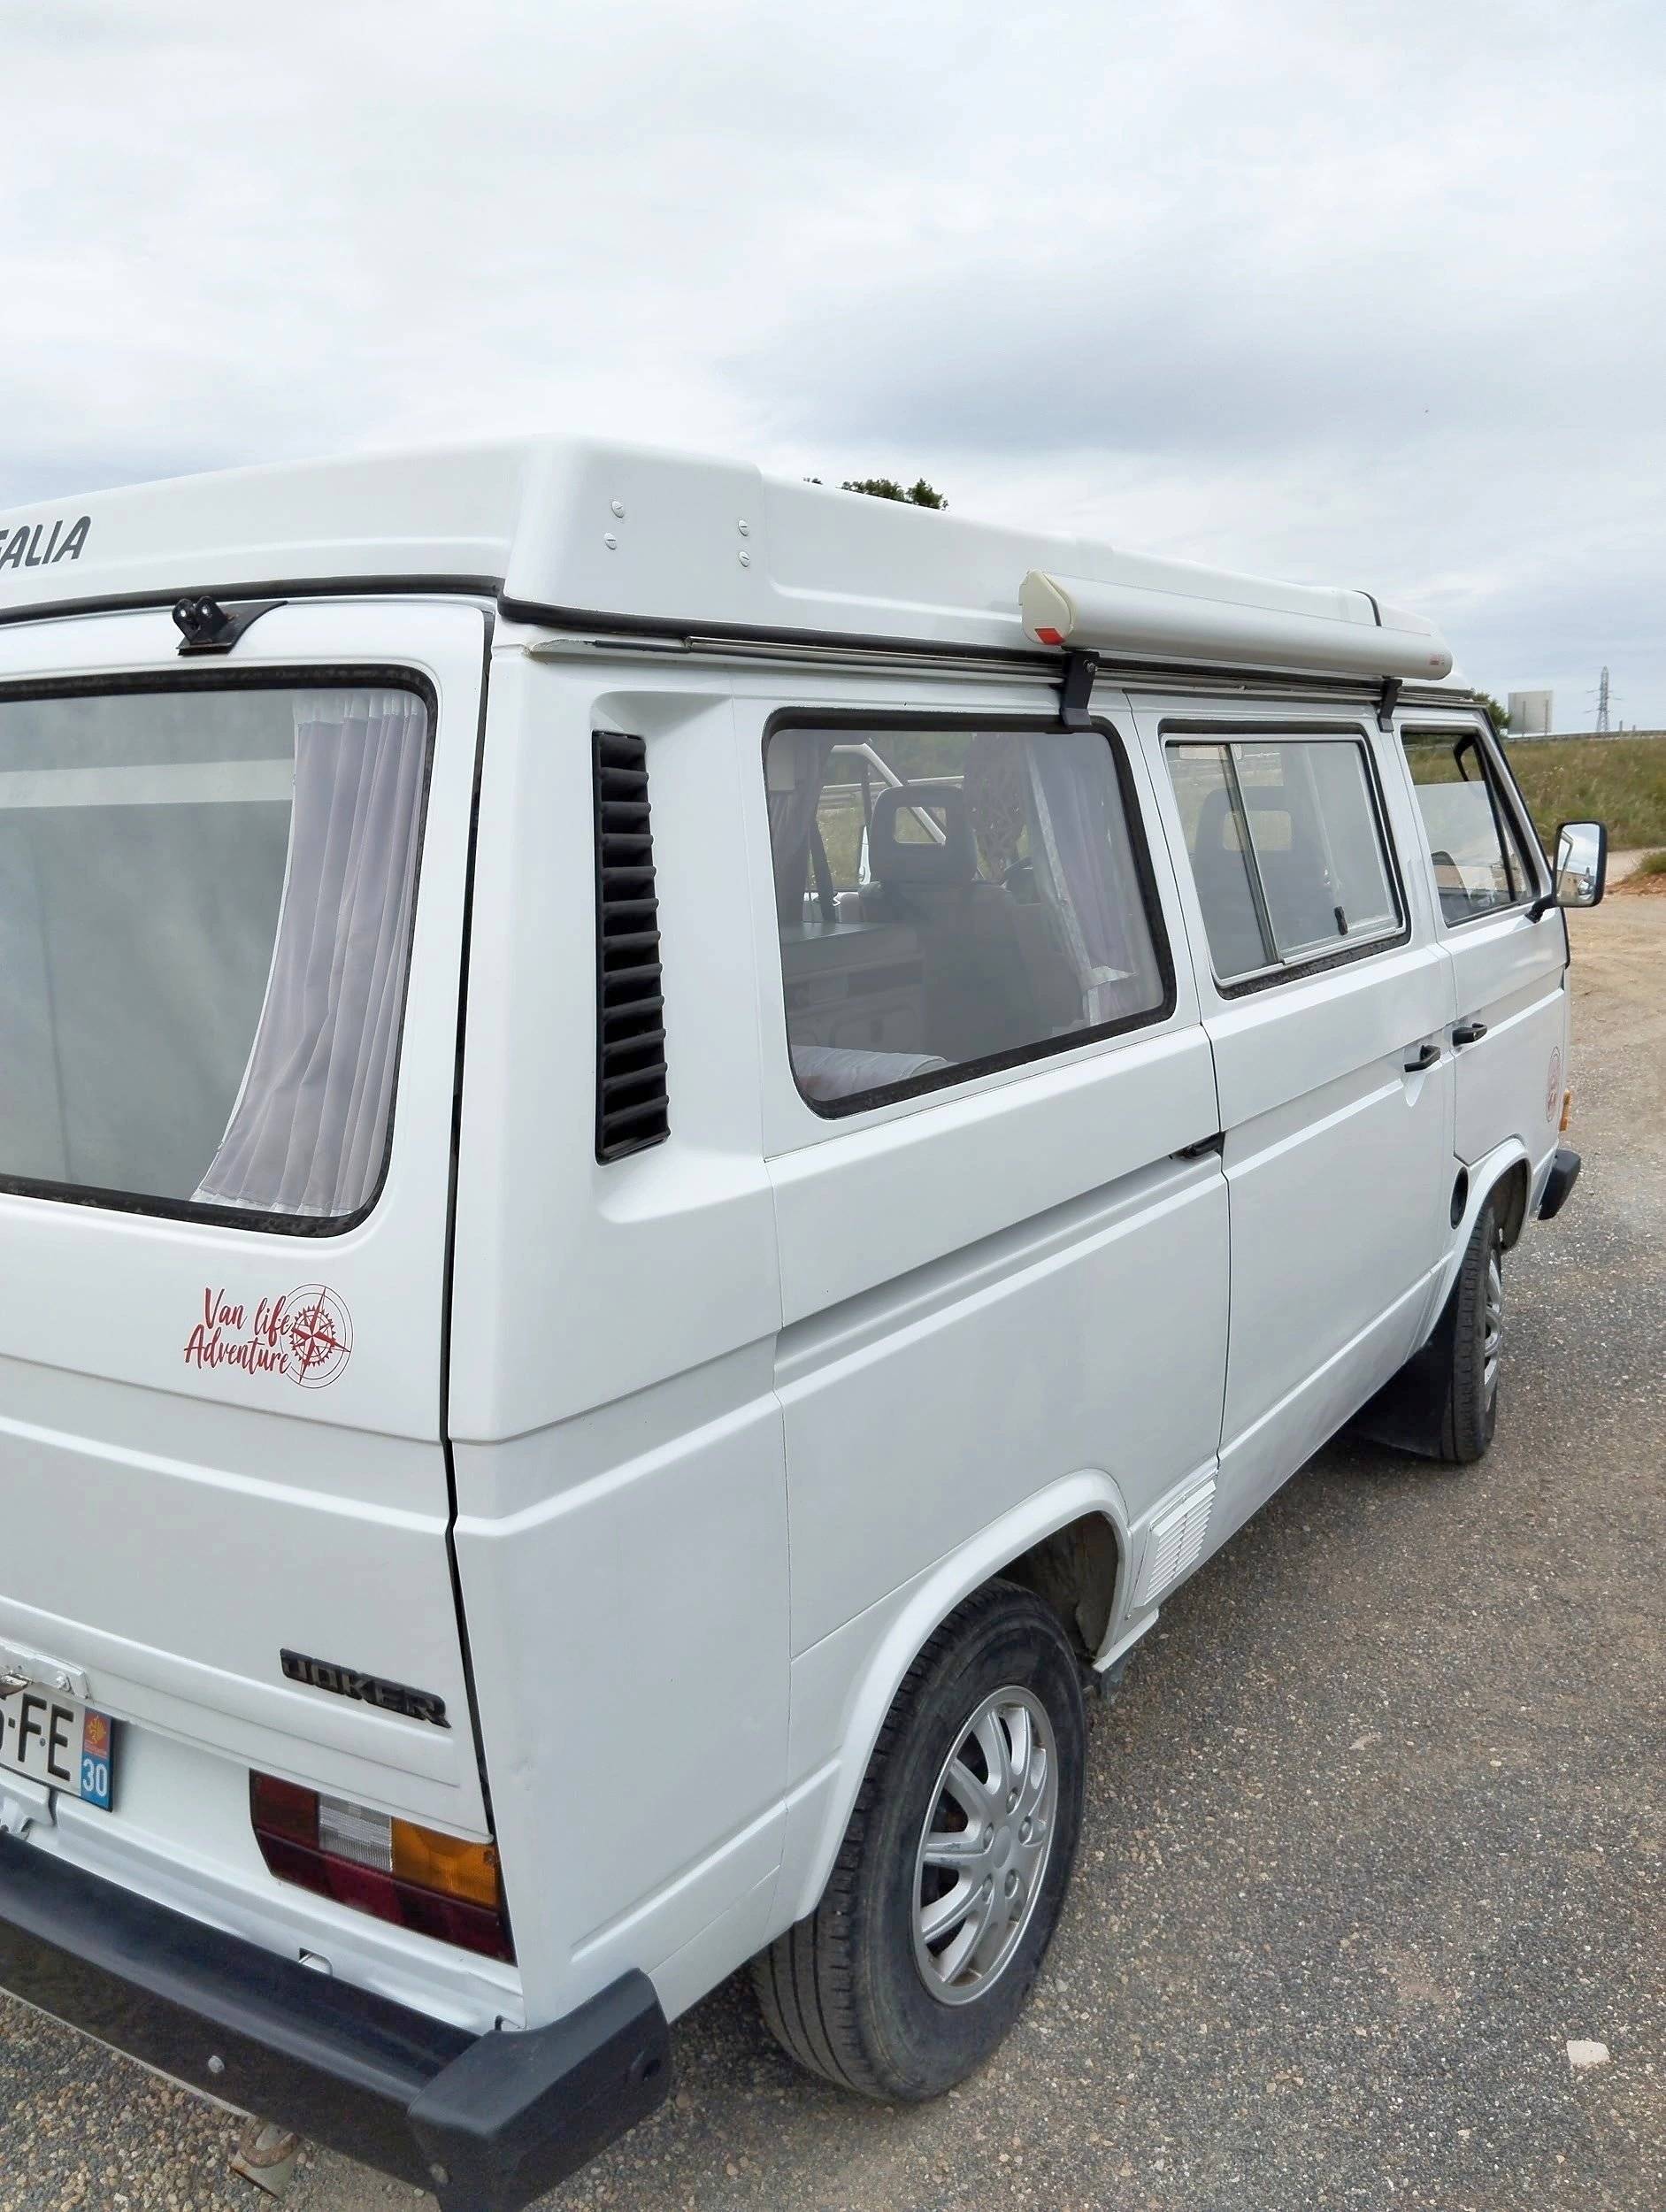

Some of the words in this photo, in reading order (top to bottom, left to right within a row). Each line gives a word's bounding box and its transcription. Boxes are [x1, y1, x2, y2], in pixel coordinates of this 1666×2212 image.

[204, 1286, 248, 1330] Van
[254, 1295, 293, 1348] life
[183, 1324, 292, 1375] Adventure
[280, 1647, 452, 1729] JOKER
[82, 1758, 108, 1797] 30
